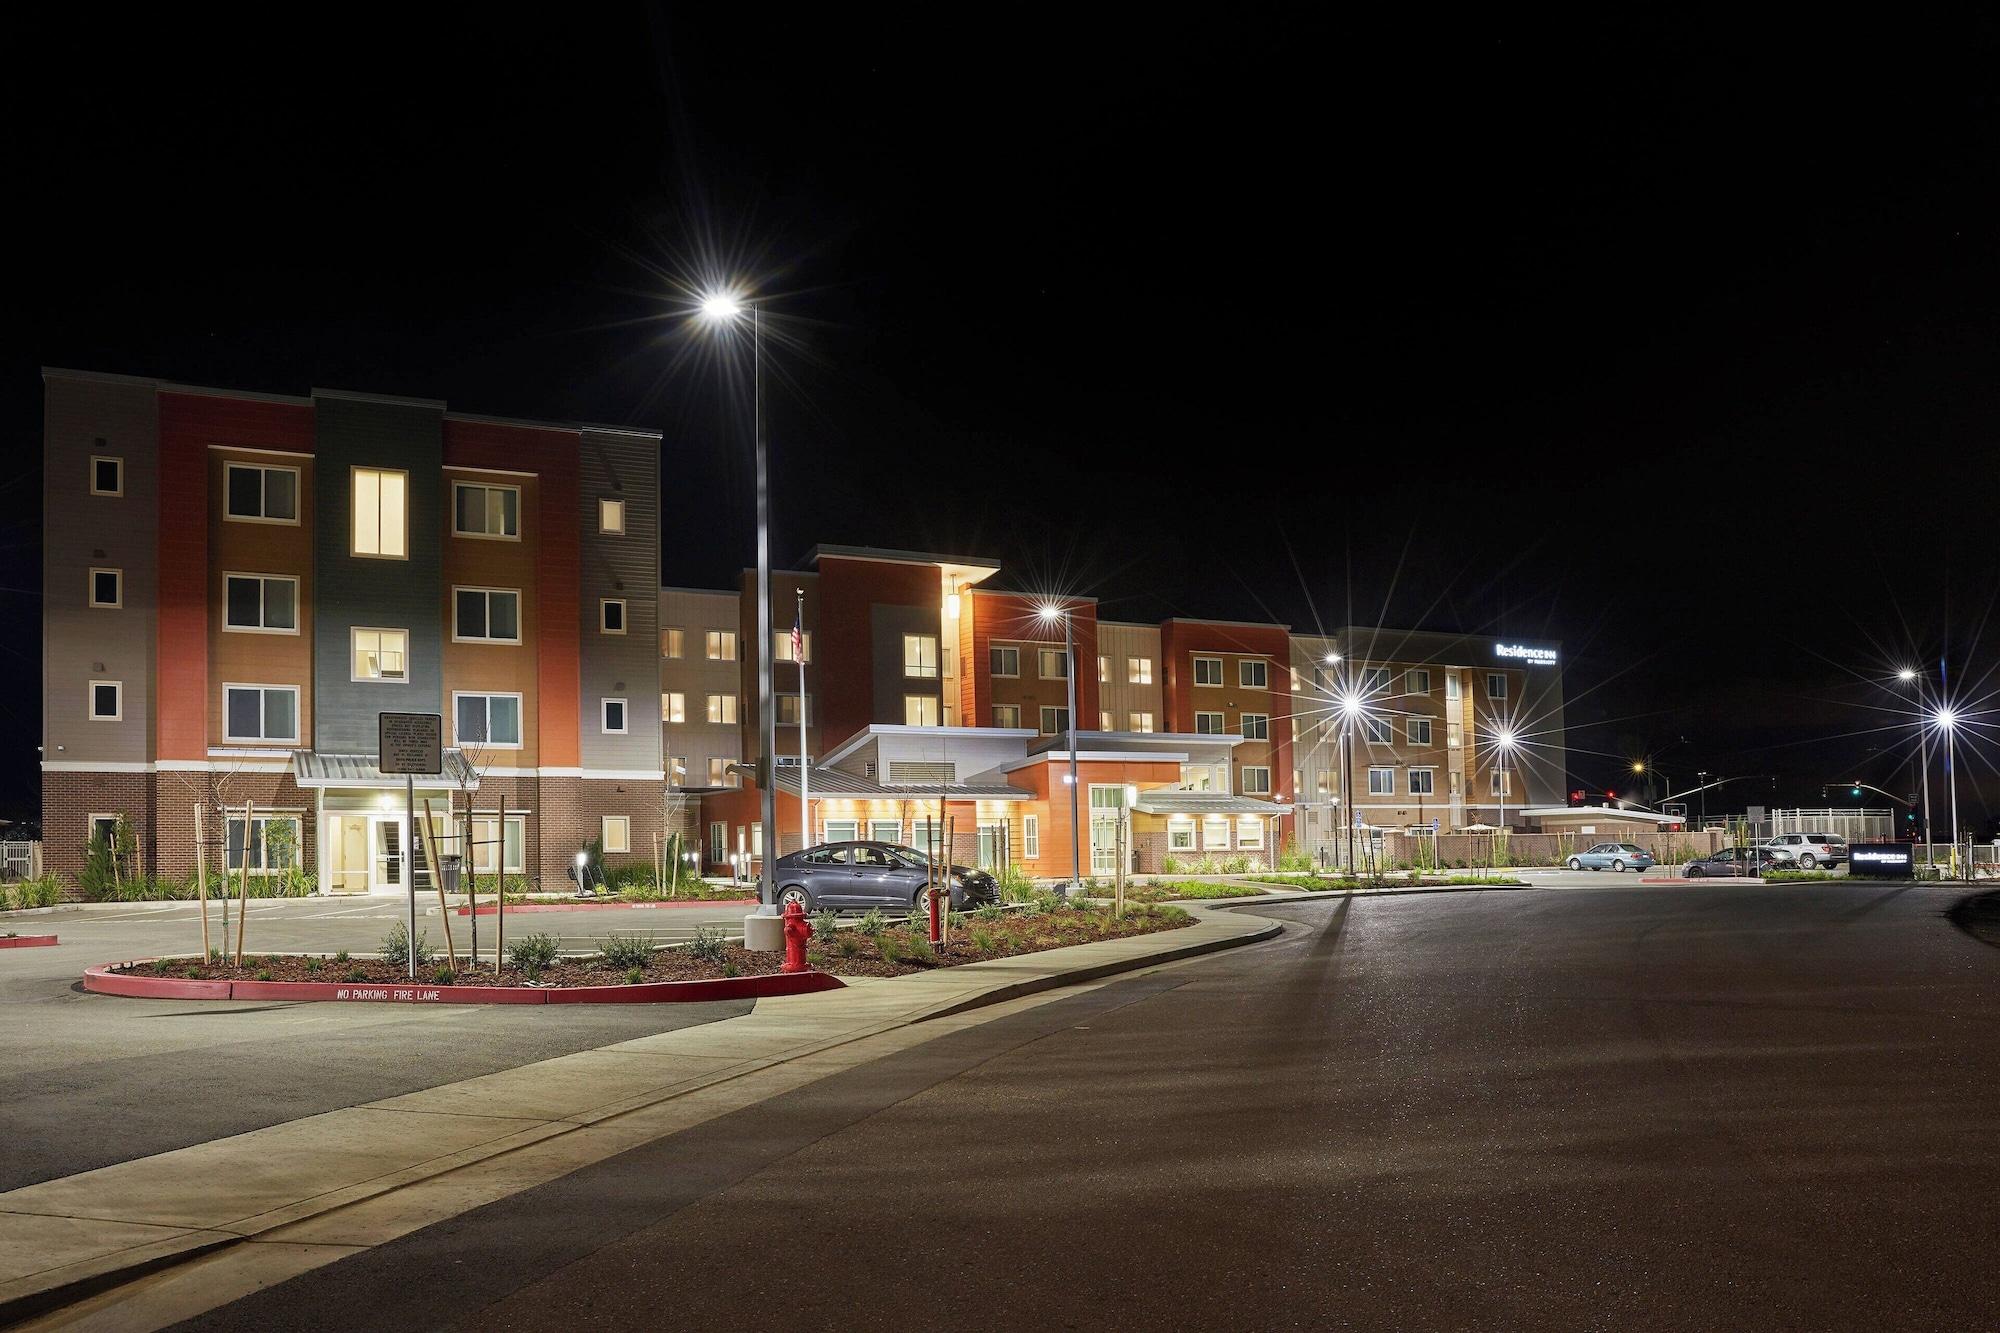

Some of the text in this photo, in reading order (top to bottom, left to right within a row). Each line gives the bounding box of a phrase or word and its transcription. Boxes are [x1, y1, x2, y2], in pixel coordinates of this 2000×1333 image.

[1496, 644, 1544, 659] Residence
[337, 989, 440, 1001] NO PARKING FIRE LANE
